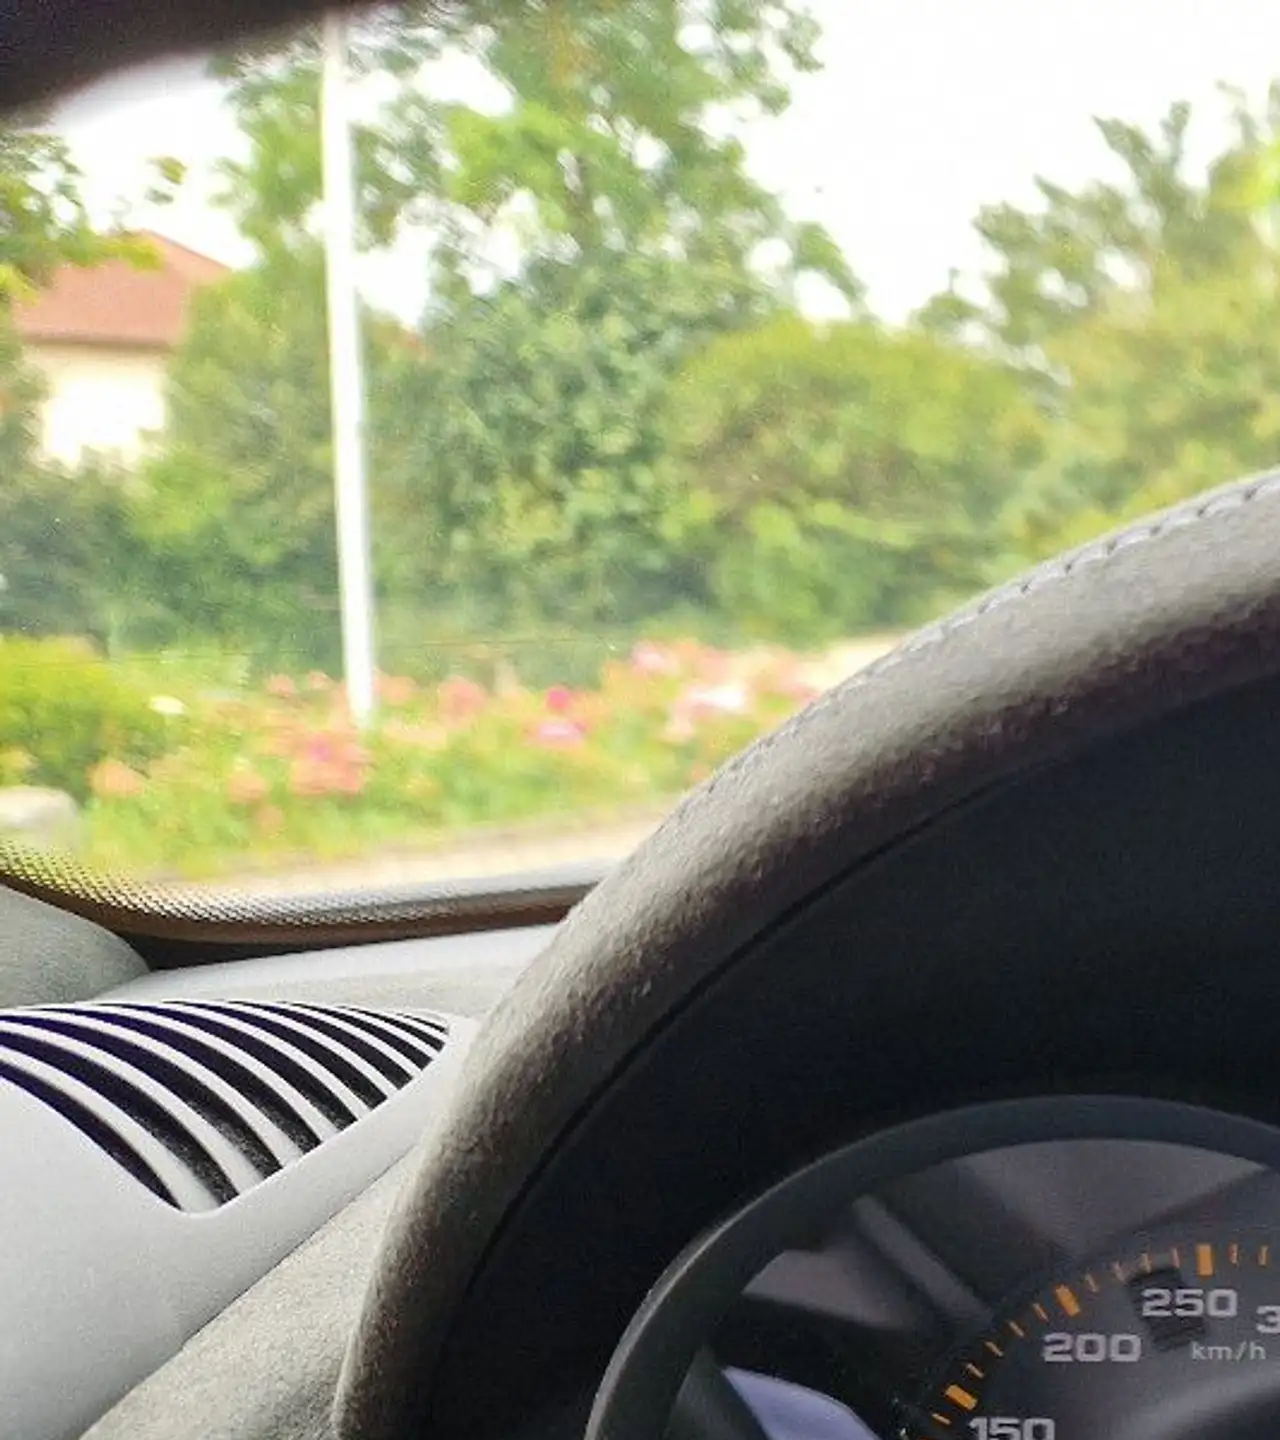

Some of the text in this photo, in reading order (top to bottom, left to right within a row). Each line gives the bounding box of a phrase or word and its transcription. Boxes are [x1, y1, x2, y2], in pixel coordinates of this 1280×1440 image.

[1141, 1287, 1238, 1318] 250
[1043, 1332, 1141, 1363] 200
[1191, 1340, 1267, 1362] km/h
